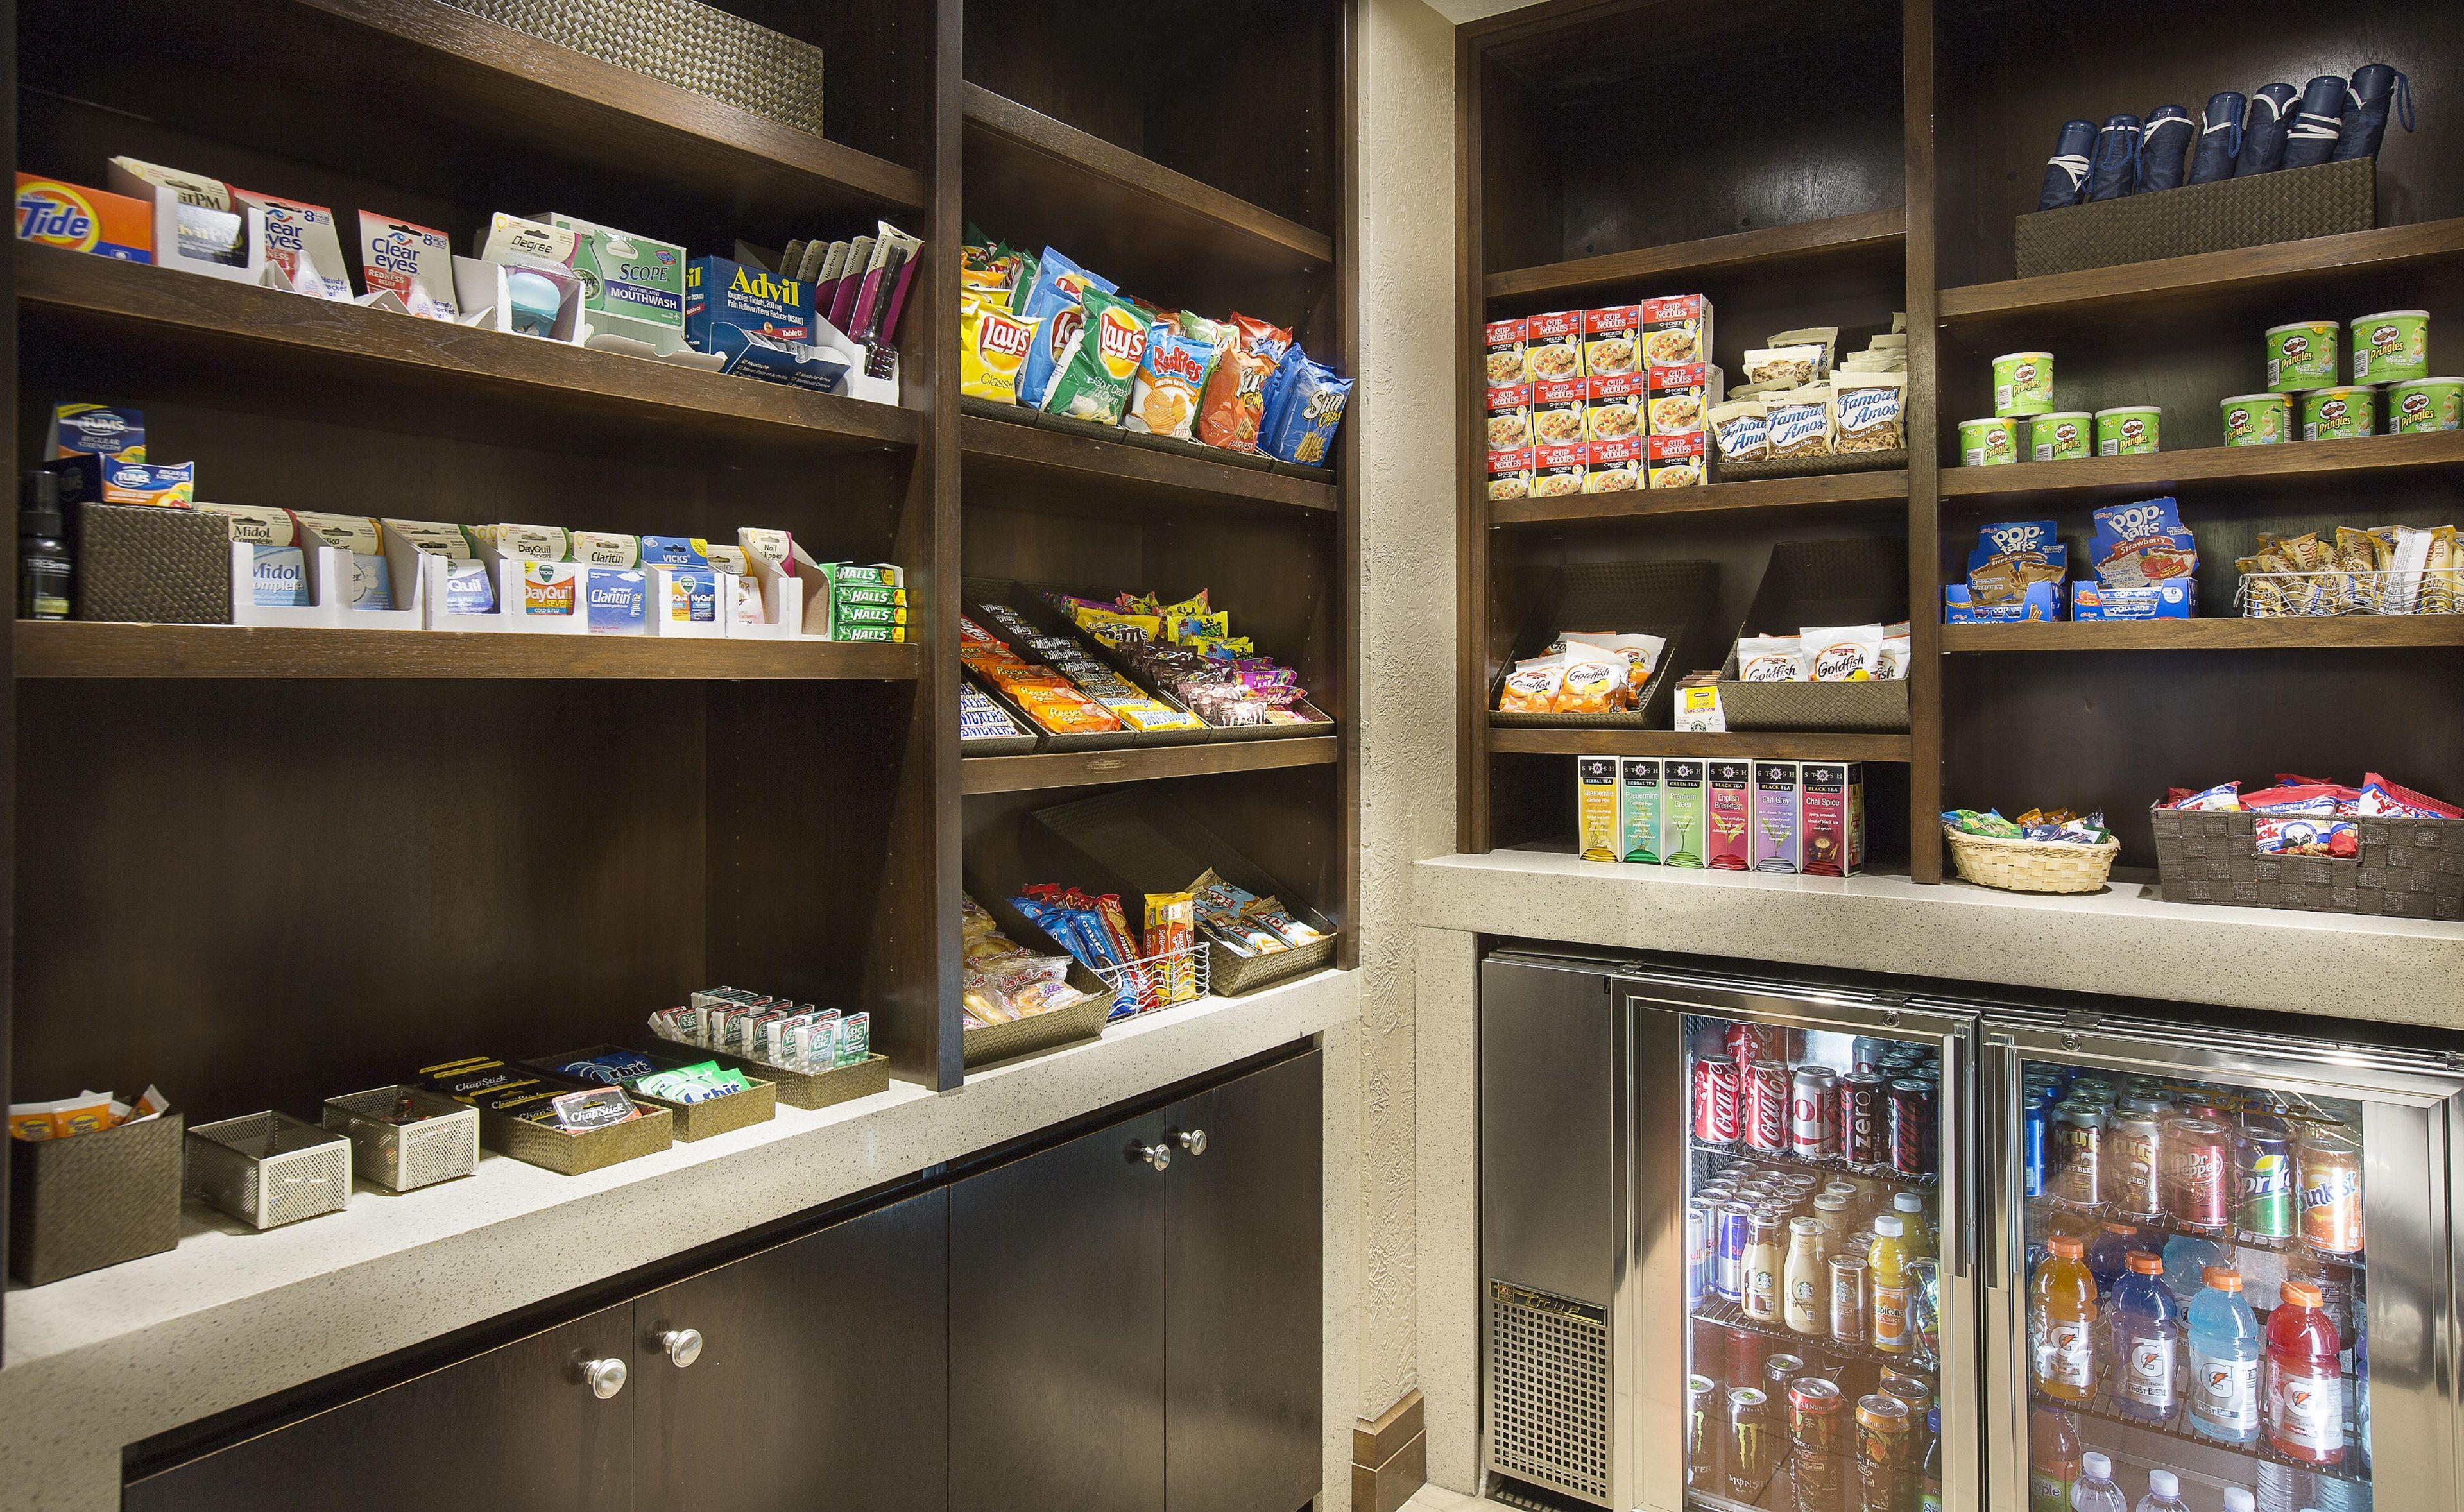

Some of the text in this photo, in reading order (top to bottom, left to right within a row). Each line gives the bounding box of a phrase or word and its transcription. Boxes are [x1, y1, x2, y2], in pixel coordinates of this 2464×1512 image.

[17, 200, 91, 238] Tide
[304, 210, 315, 222] 8
[423, 234, 433, 246] 8
[511, 235, 553, 253] Degree
[372, 238, 420, 261] Clear
[873, 237, 887, 268] Hairbrush
[375, 254, 418, 274] eyes
[825, 250, 839, 279] Hairbrush
[848, 244, 861, 274] Hairbrush
[368, 268, 405, 284] REDNESS
[619, 264, 669, 282] SCOPE
[628, 285, 647, 294] ORIGINAL
[729, 266, 800, 307] Advil
[611, 287, 677, 309] MOUTHWASH
[728, 291, 749, 302] Ibuprofen
[749, 296, 765, 306] Tablets,
[728, 300, 738, 308] Pain
[771, 309, 787, 321] Reducer
[788, 314, 804, 325] (NSAID)
[1656, 308, 1688, 319] NOODLES
[1663, 302, 1681, 311] CUP
[1540, 324, 1569, 334] NOODLES
[1546, 318, 1563, 327] CUP
[1596, 318, 1627, 329] NOODLES
[982, 316, 1031, 355] Lay's
[1101, 313, 1147, 359] Lay's
[1489, 332, 1516, 342] NOODLES
[2370, 342, 2404, 363] Pringles
[1153, 346, 1203, 383] Ruffles
[2280, 351, 2313, 372] Pringles
[1093, 376, 1129, 398] Sour Cream
[1600, 385, 1630, 395] NOODLES
[2013, 379, 2041, 397] Pringles
[1102, 391, 1118, 406] Onion
[1493, 396, 1519, 405] NOODLES
[1546, 390, 1575, 400] NOODLES
[1303, 389, 1345, 420] Sun
[1837, 389, 1898, 418] Famous
[1319, 411, 1342, 427] Chips
[1767, 405, 1825, 432] Famous
[1848, 402, 1899, 428] Amos
[2400, 409, 2434, 431] Pringles
[81, 416, 126, 431] TUMS
[1777, 418, 1824, 443] Amos
[2318, 415, 2351, 437] Pringles
[1845, 423, 1884, 439] Chocolate Chip
[2227, 423, 2254, 444] Pringles
[1228, 440, 1254, 450] HARVEST
[1775, 439, 1813, 454] Chocolate Chip
[2119, 434, 2148, 452] Pringles
[1750, 450, 1761, 459] Chip
[116, 472, 151, 484] TUMS
[234, 525, 270, 537] Midol
[518, 544, 551, 555] DayQuil
[2120, 537, 2166, 555] Strawberry
[591, 552, 624, 563] Claritin
[662, 554, 689, 563] VICKS
[1992, 557, 2008, 566] Brown
[839, 568, 877, 580] HALLS
[591, 589, 631, 604] Claritin
[691, 594, 714, 603] NyQuil
[850, 590, 888, 602] HALLS
[853, 609, 889, 620] HALLS
[850, 629, 887, 640] HALLS
[1818, 655, 1865, 677] Goldfish
[1569, 668, 1609, 682] Goldfish
[1020, 686, 1054, 697] Reese's
[1049, 708, 1082, 717] Reese's
[1625, 791, 1658, 799] Peppermint
[1718, 794, 1740, 803] English
[1775, 796, 1790, 806] Grey
[1806, 797, 1840, 807] Chai Spice
[1715, 801, 1743, 810] Breakfast
[2273, 802, 2307, 813] Original
[1082, 921, 1106, 955] OREO
[817, 1032, 830, 1042] tic
[848, 1033, 862, 1042] tac
[850, 1026, 863, 1035] tic
[814, 1040, 828, 1049] tac
[455, 1075, 508, 1091] ChapStick
[570, 1103, 626, 1123] ChapStick
[1855, 1091, 1871, 1149] zero
[2187, 1153, 2208, 1167] Dr
[2058, 1163, 2096, 1175] ROOT BEER
[2128, 1175, 2147, 1185] BEER
[2051, 1325, 2080, 1358] G
[2131, 1344, 2164, 1377] G
[2200, 1362, 2234, 1398] G
[2128, 1384, 2147, 1394] FROST
[2198, 1403, 2216, 1414] FROST
[1792, 1436, 1813, 1450] Green
[1865, 1458, 1879, 1470] Tea
